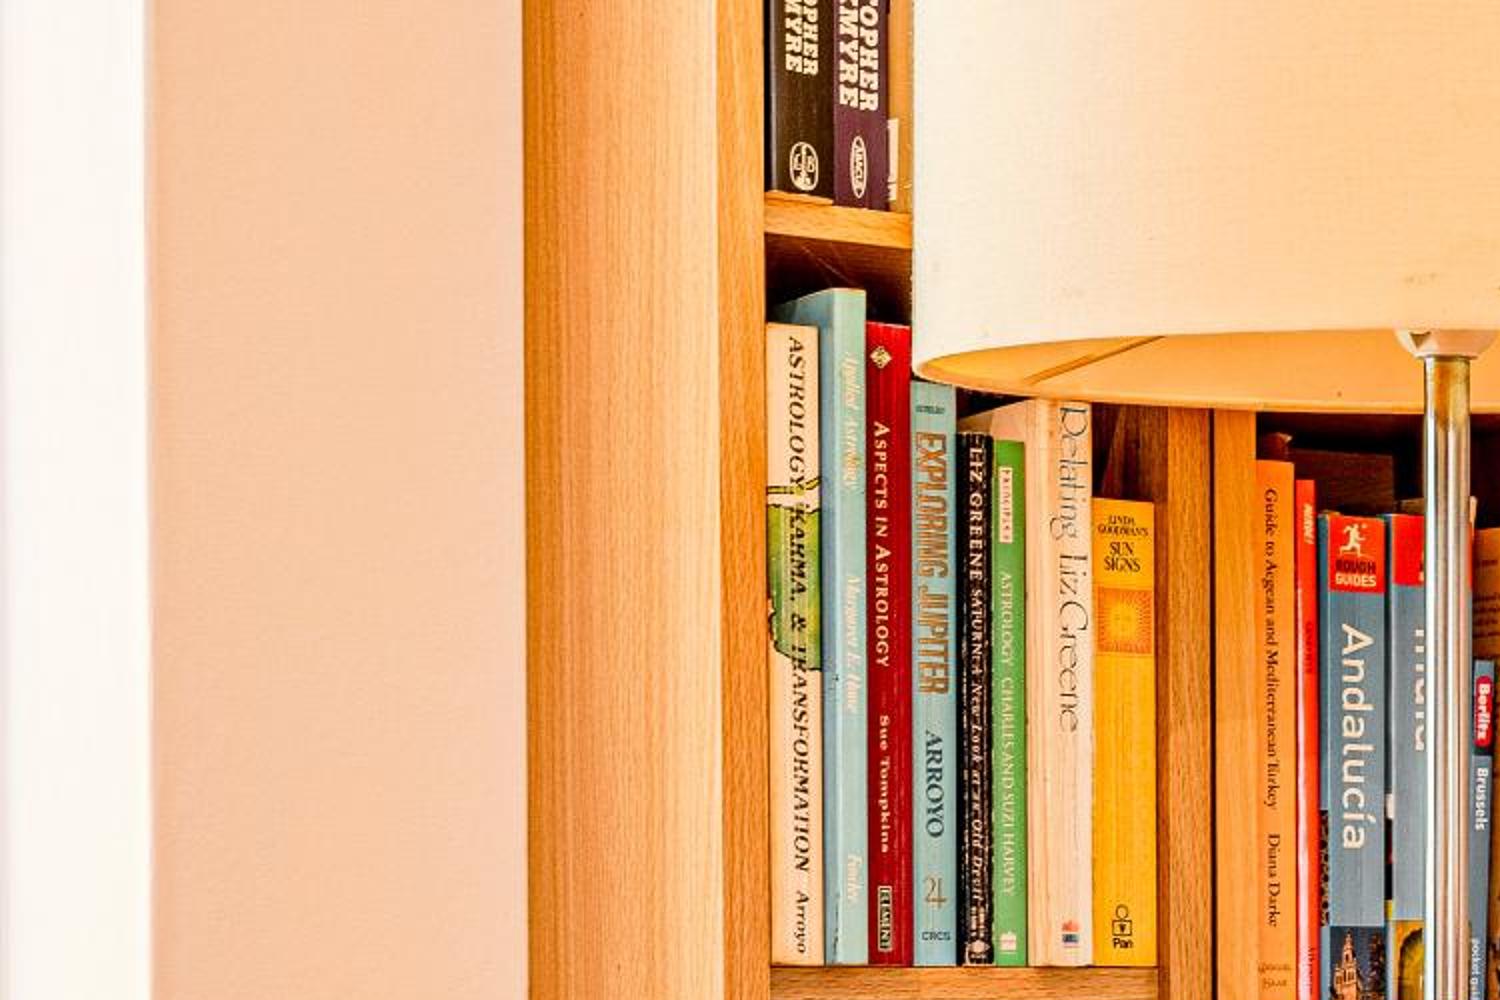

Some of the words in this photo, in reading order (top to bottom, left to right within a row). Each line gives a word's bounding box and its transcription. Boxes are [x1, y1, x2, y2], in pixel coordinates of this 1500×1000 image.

[788, 336, 807, 487] ASTROLOGY
[873, 421, 891, 509] ASPECTS
[969, 447, 983, 482] LIZ
[874, 516, 889, 537] IN
[915, 431, 948, 578] EXPLORING
[1265, 488, 1279, 537] Guide
[969, 492, 983, 580] GREENE
[1266, 541, 1278, 556] to
[874, 545, 893, 667] ASTROLOGY
[1262, 561, 1279, 618] Aegean
[1335, 572, 1377, 588] GUIDES
[790, 612, 806, 632] &
[917, 586, 951, 695] JUPITER
[1001, 573, 1014, 664] ASTROLOGY
[1265, 621, 1279, 647] and
[972, 683, 983, 716] New
[1001, 677, 1014, 754] CHARLES
[1266, 650, 1281, 757] Mediterranean
[1476, 683, 1491, 741] Berlitz
[791, 644, 811, 873] TRANSFORMATION
[879, 715, 891, 751] Sue
[971, 724, 983, 765] Look
[1341, 624, 1376, 850] Andalucía
[924, 730, 945, 838] ARROYO
[1002, 754, 1014, 789] AND
[1264, 759, 1283, 809] Turkey
[1474, 767, 1490, 831] Brussels
[877, 757, 893, 854] Tompkins
[1002, 793, 1015, 828] SUZI
[1002, 833, 1016, 897] HARVEY
[1267, 833, 1282, 879] Diana
[795, 890, 810, 955] Arroyo
[1268, 881, 1282, 927] Darke
[1112, 937, 1133, 949] Pan
[1469, 937, 1482, 975] pocket
